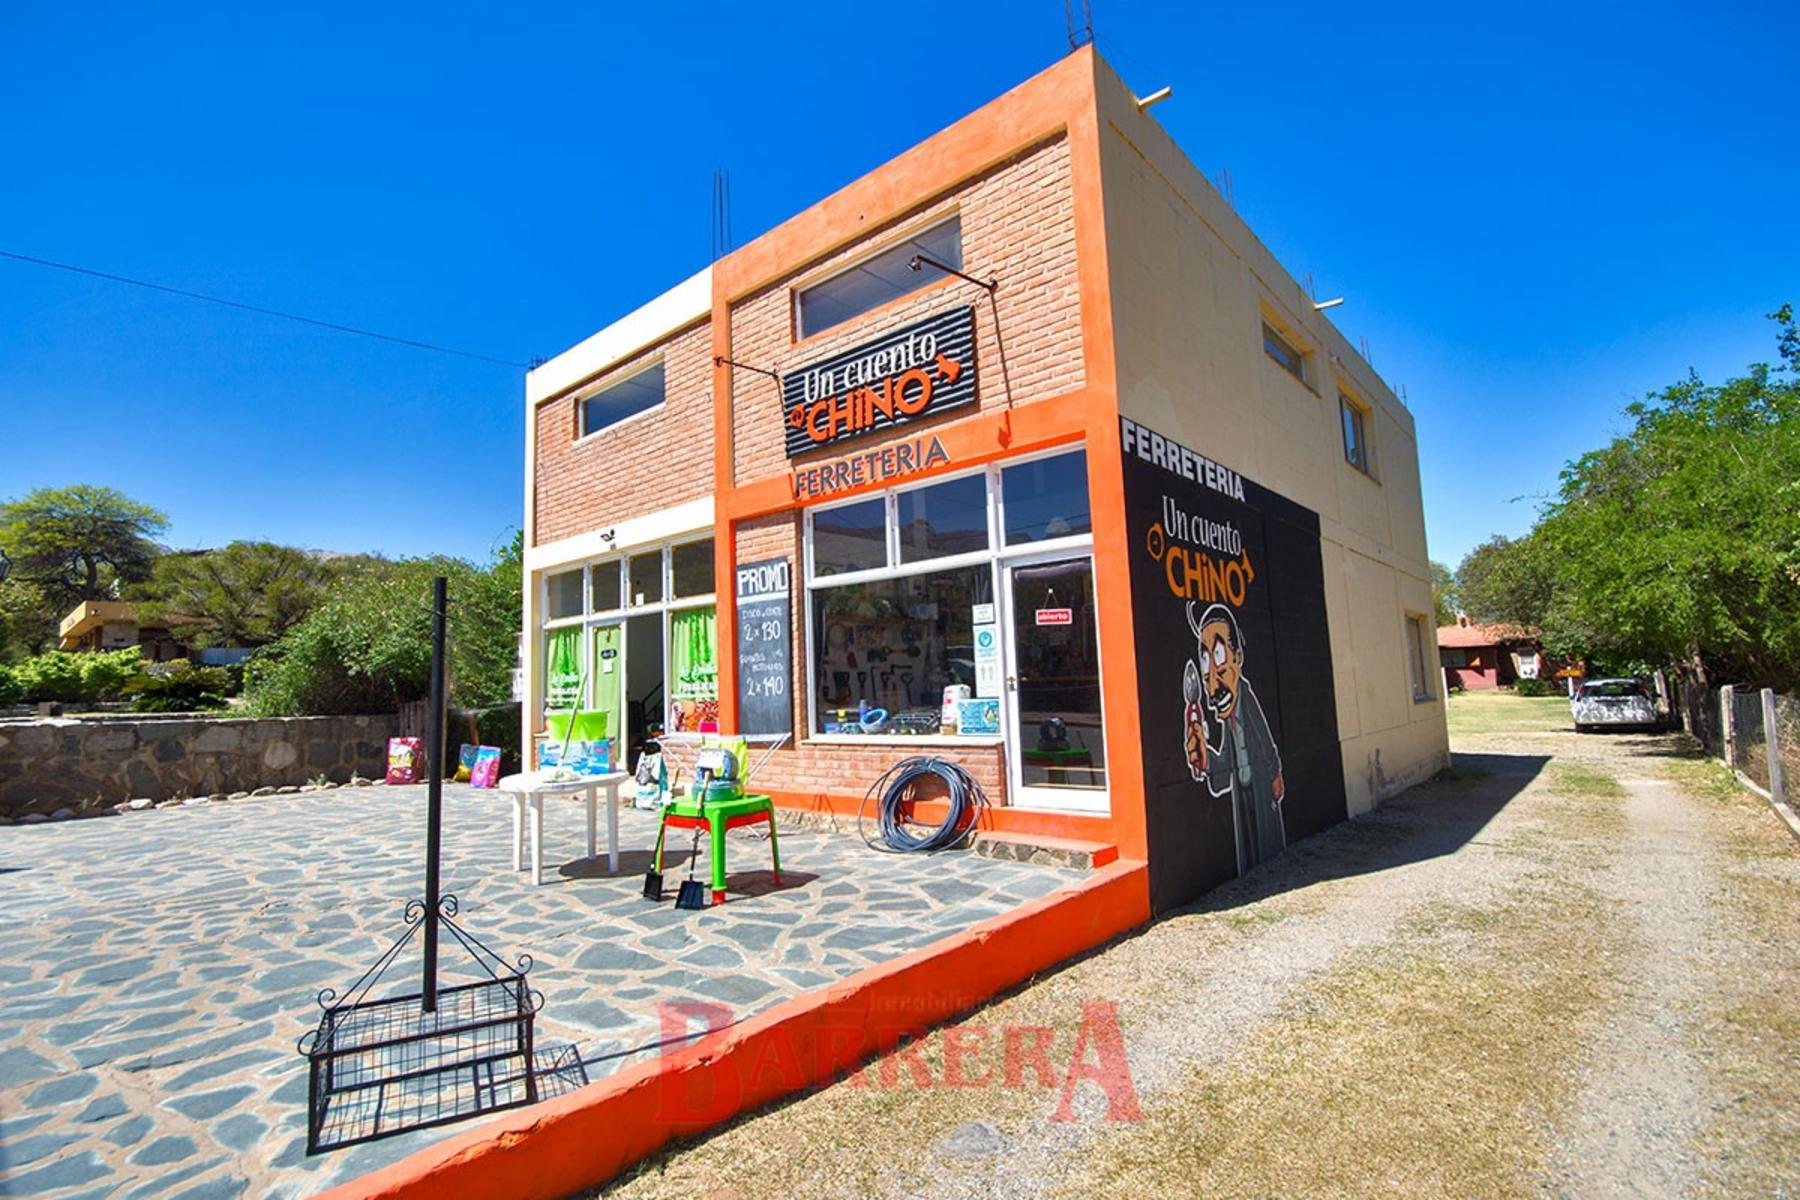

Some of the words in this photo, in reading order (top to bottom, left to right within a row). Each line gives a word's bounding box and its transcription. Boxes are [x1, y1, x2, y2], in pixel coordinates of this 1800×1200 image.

[803, 367, 835, 402] Un
[843, 333, 937, 387] cuento
[795, 435, 949, 498] FERRETERIA
[1121, 417, 1246, 503] FERRETERIA
[1162, 495, 1190, 542] Un
[1191, 515, 1242, 556] cuento
[738, 562, 787, 595] PROMO
